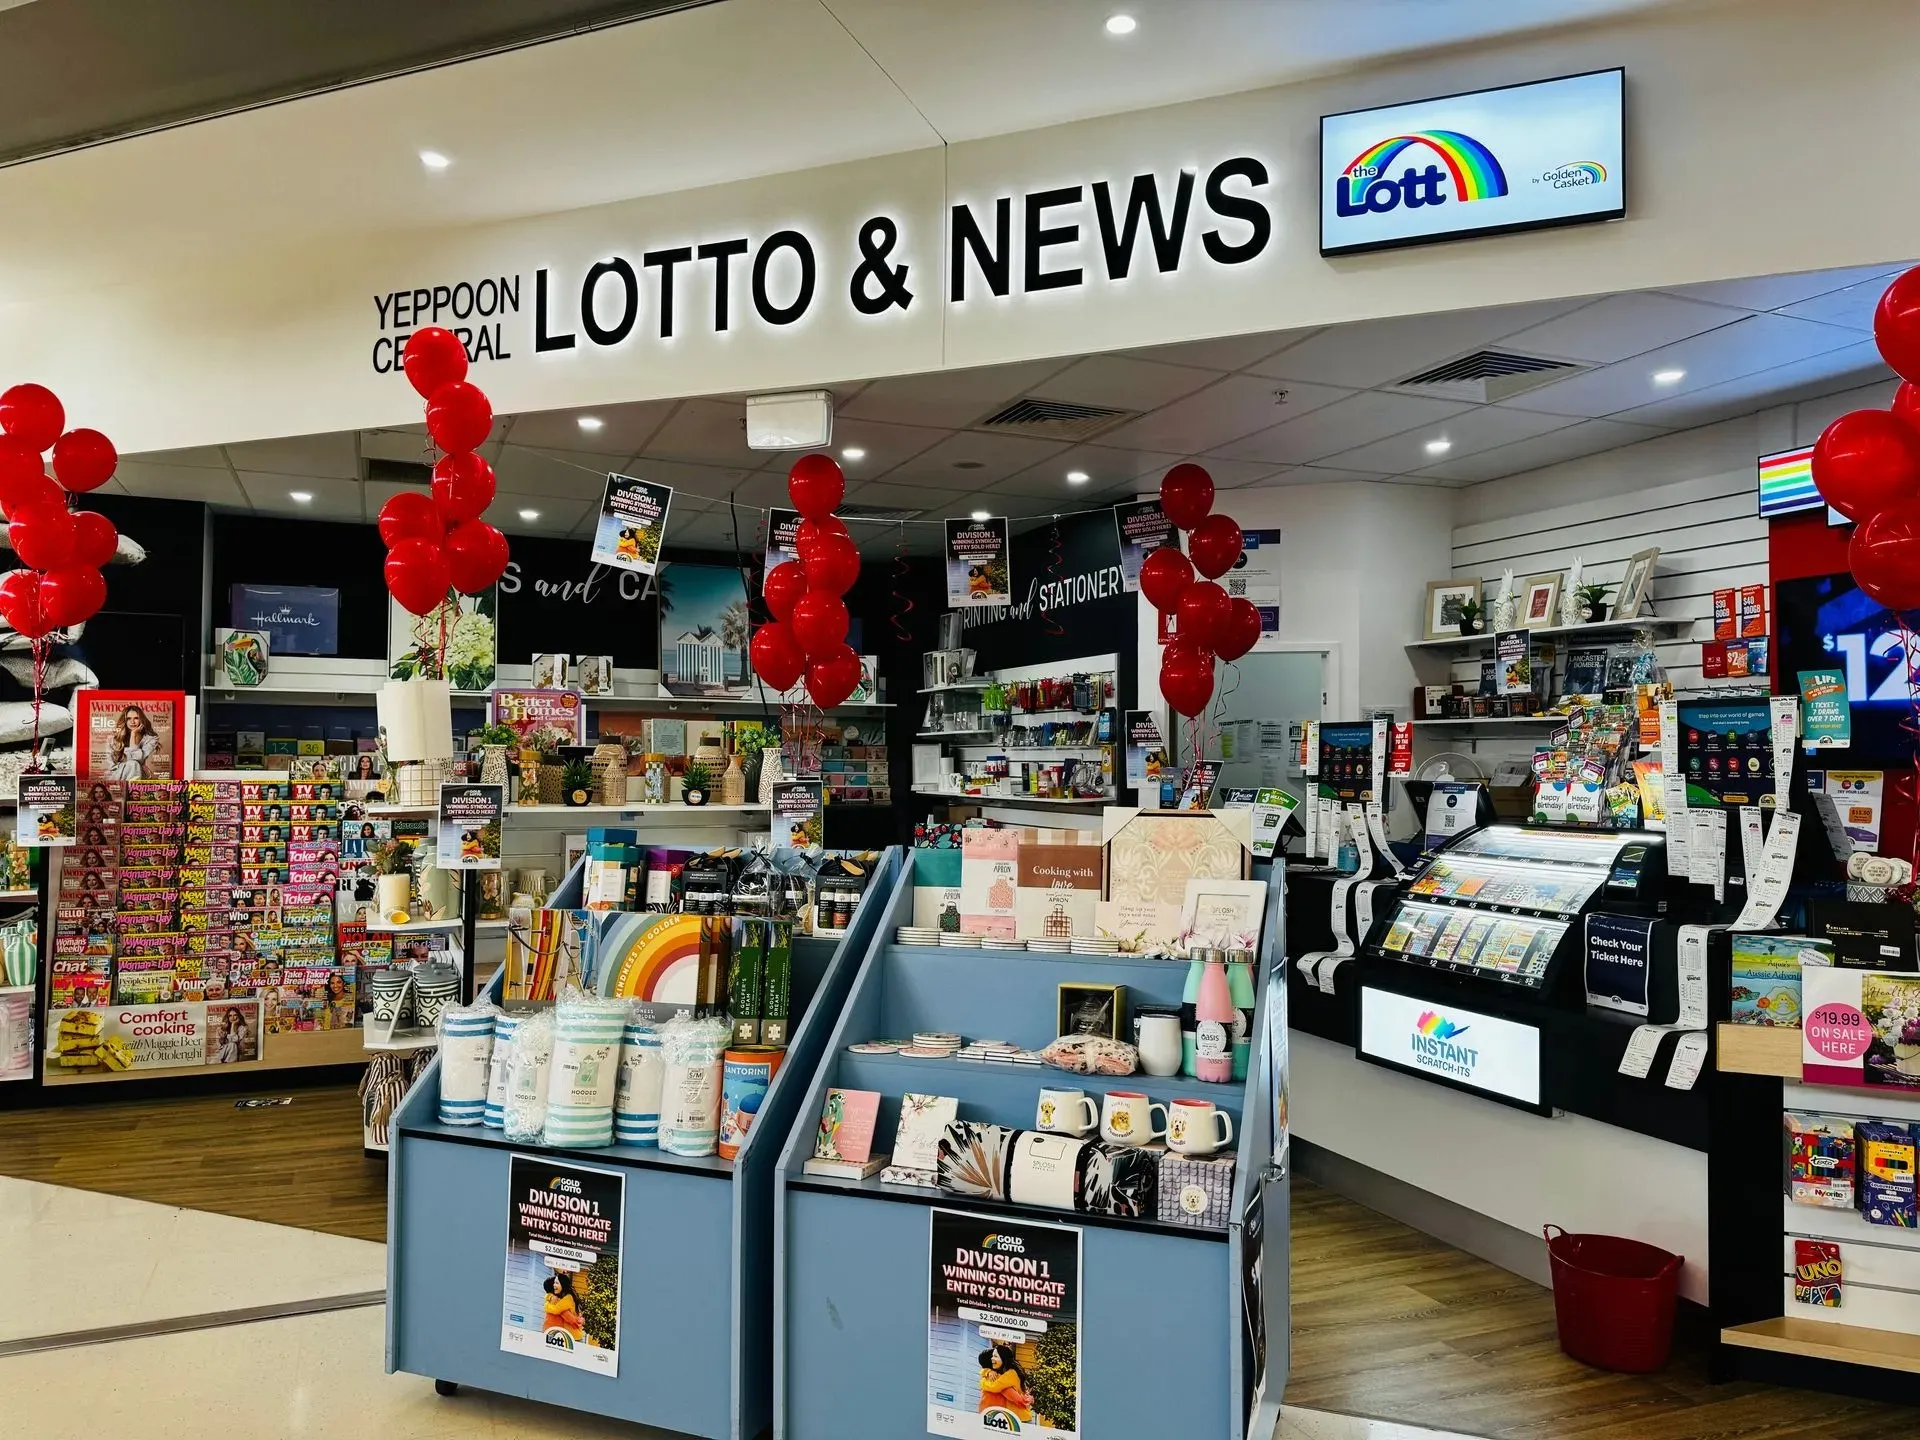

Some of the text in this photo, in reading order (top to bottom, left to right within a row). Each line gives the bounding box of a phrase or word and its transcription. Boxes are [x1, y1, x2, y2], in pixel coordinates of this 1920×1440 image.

[1353, 165, 1377, 178] the
[1532, 168, 1582, 185] by Golden
[1553, 177, 1590, 189] Casket
[1337, 165, 1446, 217] Lott
[536, 157, 1272, 352] LOTTO & NEWS
[374, 275, 520, 330] YEPPOON
[373, 323, 511, 373] CERAL
[616, 489, 652, 503] DIVISION
[957, 531, 990, 539] DIVISION
[535, 564, 612, 603] and
[250, 610, 321, 628] Hallmark
[1568, 654, 1607, 663] LANCASTER
[1573, 661, 1600, 669] BOMBER
[499, 693, 554, 708] Better
[512, 706, 575, 721] Homes
[91, 717, 116, 728] Elle
[167, 782, 183, 792] Day
[188, 783, 215, 792] New
[243, 784, 259, 794] TV
[296, 784, 312, 794] TV
[1540, 794, 1560, 804] Happy
[1572, 795, 1591, 805] Happy
[189, 804, 216, 812] New
[244, 805, 261, 815] TV
[291, 805, 309, 815] TV
[1537, 801, 1564, 810] Birthday!
[1567, 802, 1595, 811] Birthday!
[245, 826, 261, 836] TV
[293, 826, 309, 836] TV
[289, 851, 315, 861] Take
[243, 869, 258, 879] TV
[993, 864, 1011, 873] APRON
[1033, 866, 1094, 880] Cooking with
[289, 871, 315, 882] Take
[1051, 877, 1075, 890] love
[232, 889, 251, 899] Who
[944, 891, 961, 900] APRON
[58, 909, 85, 918] HELLO!
[229, 911, 249, 921] Who
[56, 937, 87, 947] Woman's
[1591, 936, 1643, 952] Check Your
[56, 944, 85, 954] Weekly
[616, 916, 681, 999] KINDNESS IS GOLDEN
[1591, 950, 1643, 967] Ticket Here
[53, 960, 88, 973] Chat
[306, 970, 324, 979] Take
[1746, 969, 1771, 978] Aussie
[176, 978, 207, 991] Yours
[232, 976, 281, 988] Pick Me Up!
[306, 977, 329, 985] Break
[1868, 984, 1908, 998] Health
[119, 1010, 188, 1024] Comfort
[1815, 1010, 1860, 1027] $19.99
[133, 1022, 196, 1037] cooking
[1811, 1026, 1866, 1042] ON SALE
[122, 1036, 203, 1051] with Maggie Beer
[1821, 1043, 1856, 1055] HERE
[1411, 1033, 1478, 1068] INSTANT
[130, 1049, 202, 1064] and Ottolenghi
[724, 1067, 767, 1076] SANTORINI
[1033, 1160, 1056, 1169] SPLOSH
[561, 1178, 580, 1187] GOLD
[561, 1185, 582, 1194] LOTTO
[529, 1189, 599, 1216] DIVISION 1
[518, 1203, 611, 1231] WINNING SYNDICATE
[521, 1216, 607, 1242] ENTRY SOLD HERE!
[997, 1234, 1023, 1245] GOLD
[997, 1242, 1025, 1253] LOTTO
[956, 1247, 1050, 1278] DIVISION 1
[1796, 1259, 1842, 1281] UNO
[943, 1264, 1065, 1295] WINNING SYNDICATE
[946, 1279, 1061, 1309] ENTRY SOLD HERE!
